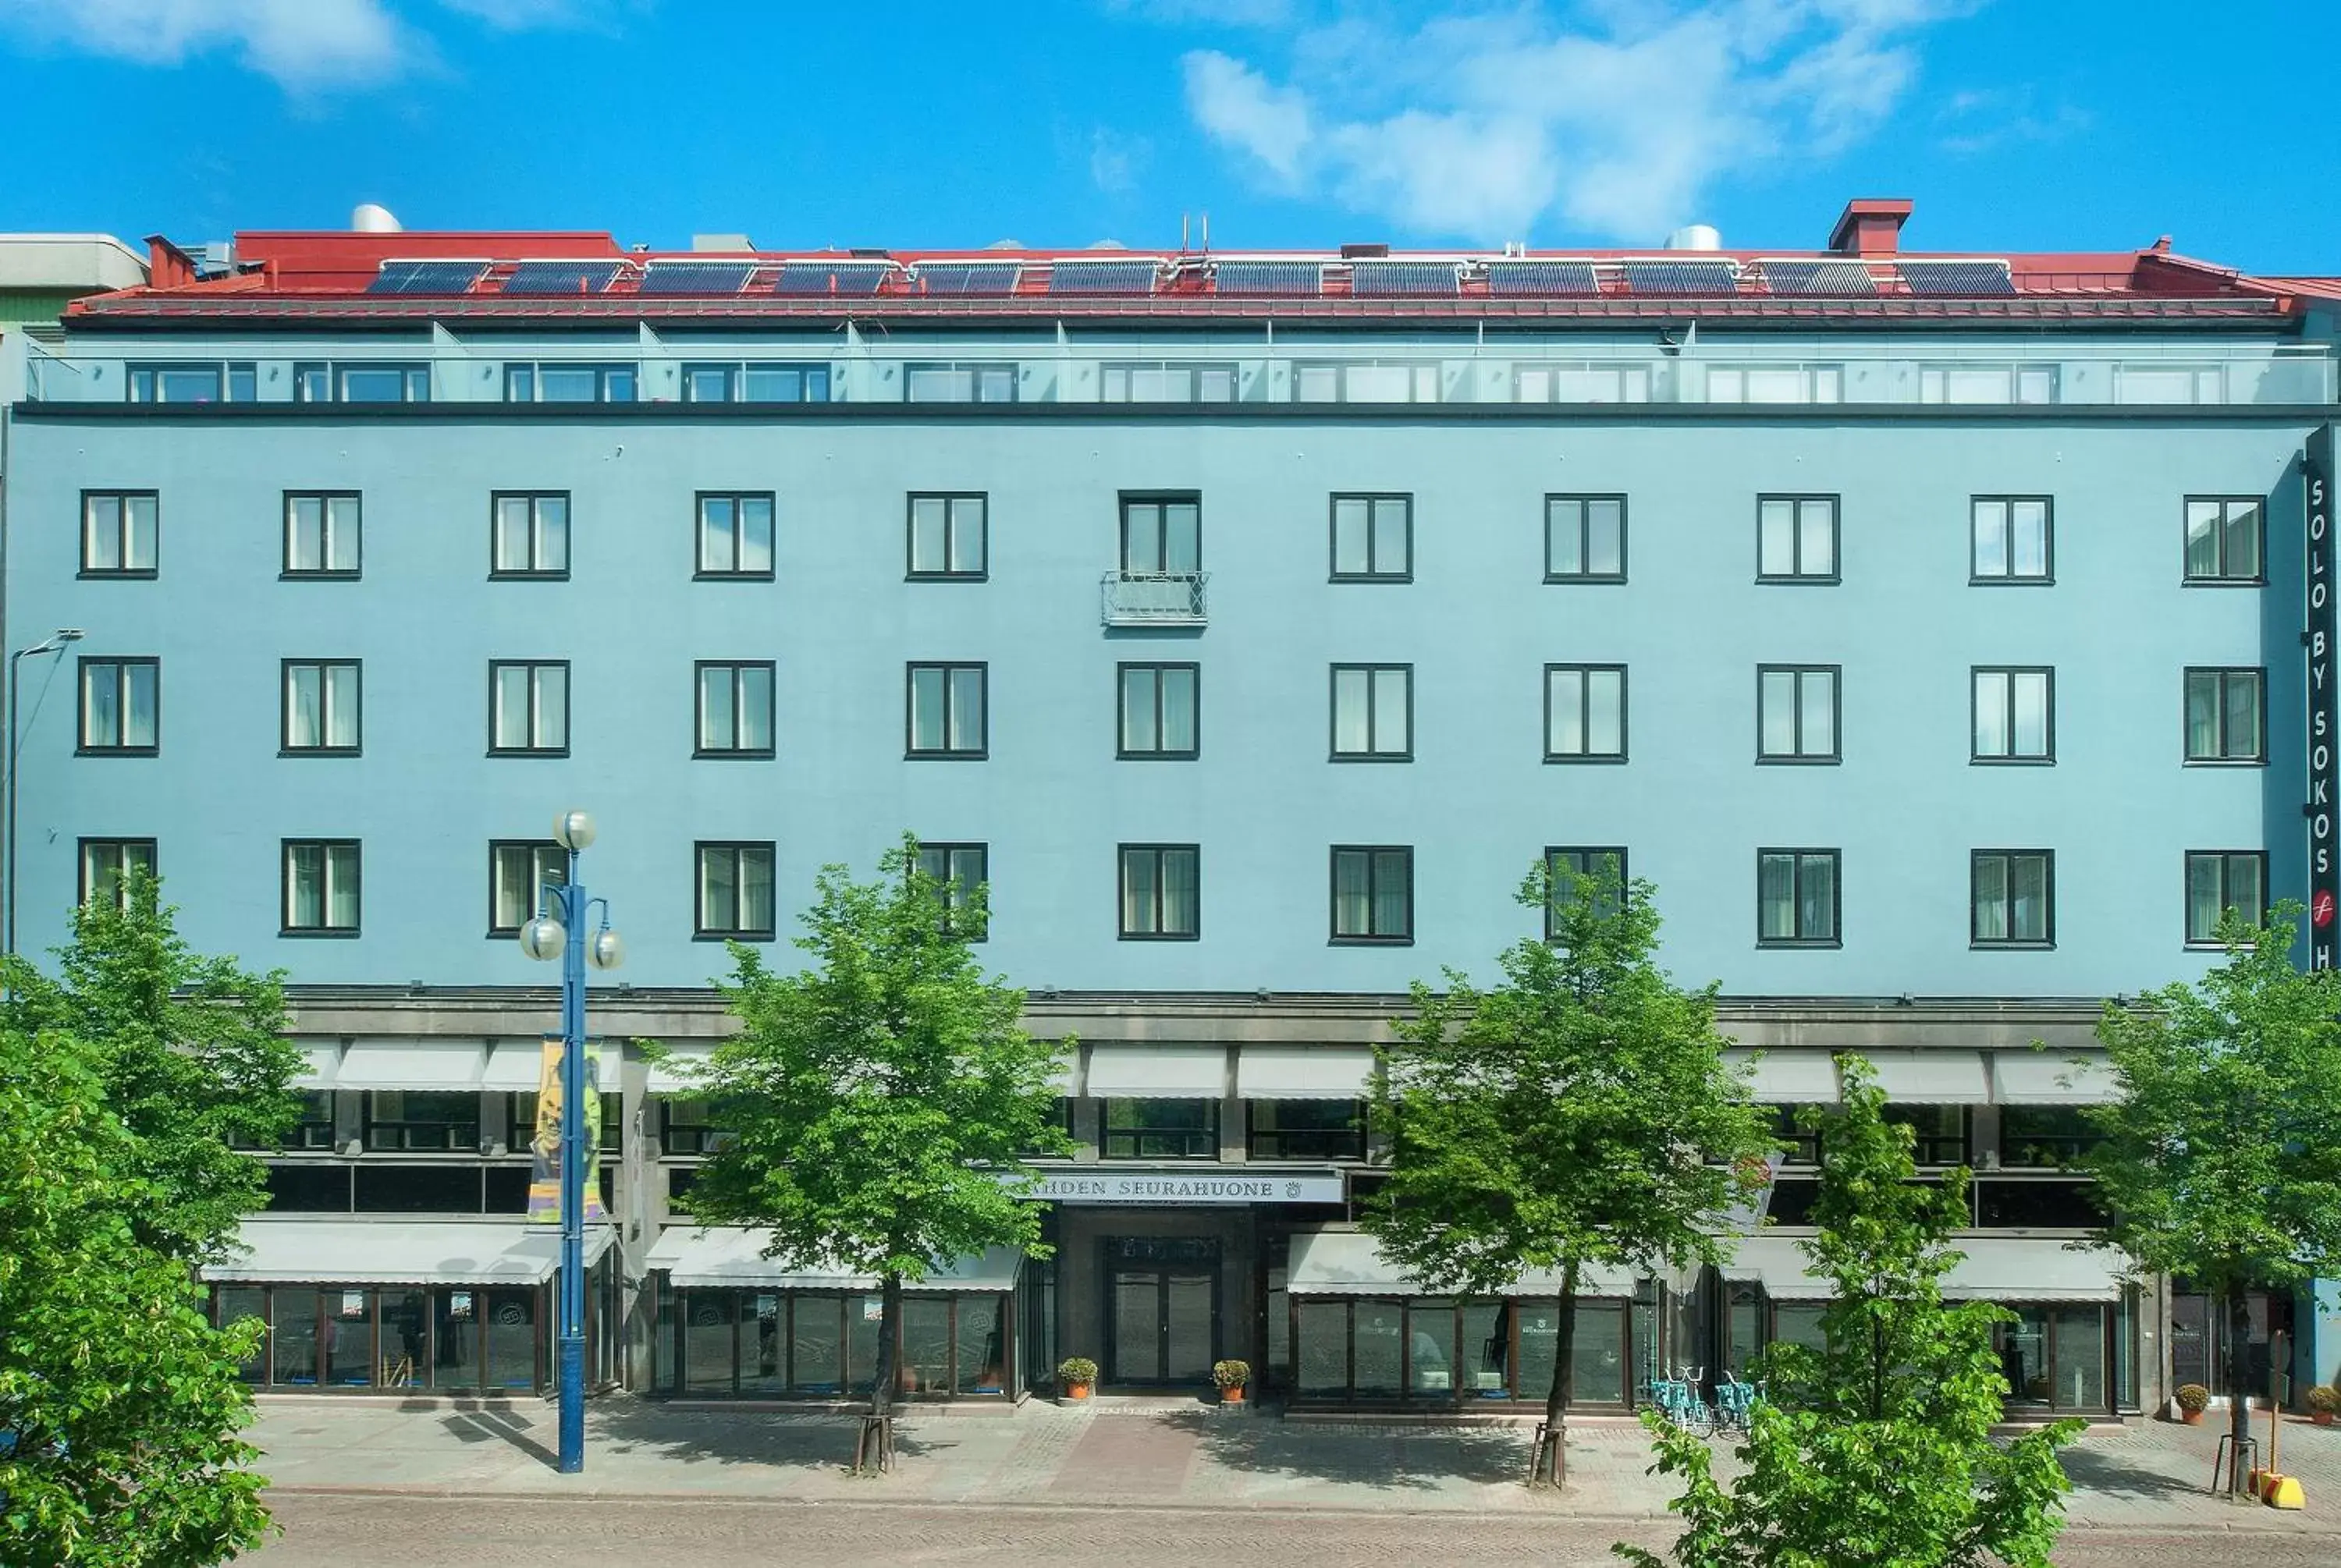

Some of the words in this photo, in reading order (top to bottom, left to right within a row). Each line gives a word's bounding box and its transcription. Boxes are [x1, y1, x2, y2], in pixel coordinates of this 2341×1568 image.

[2311, 480, 2326, 608] SOLO
[2313, 630, 2326, 690] BY
[2313, 711, 2329, 873] SOKOS
[1034, 1180, 1107, 1194] HDEN
[1118, 1181, 1273, 1196] SEURAHUONE
